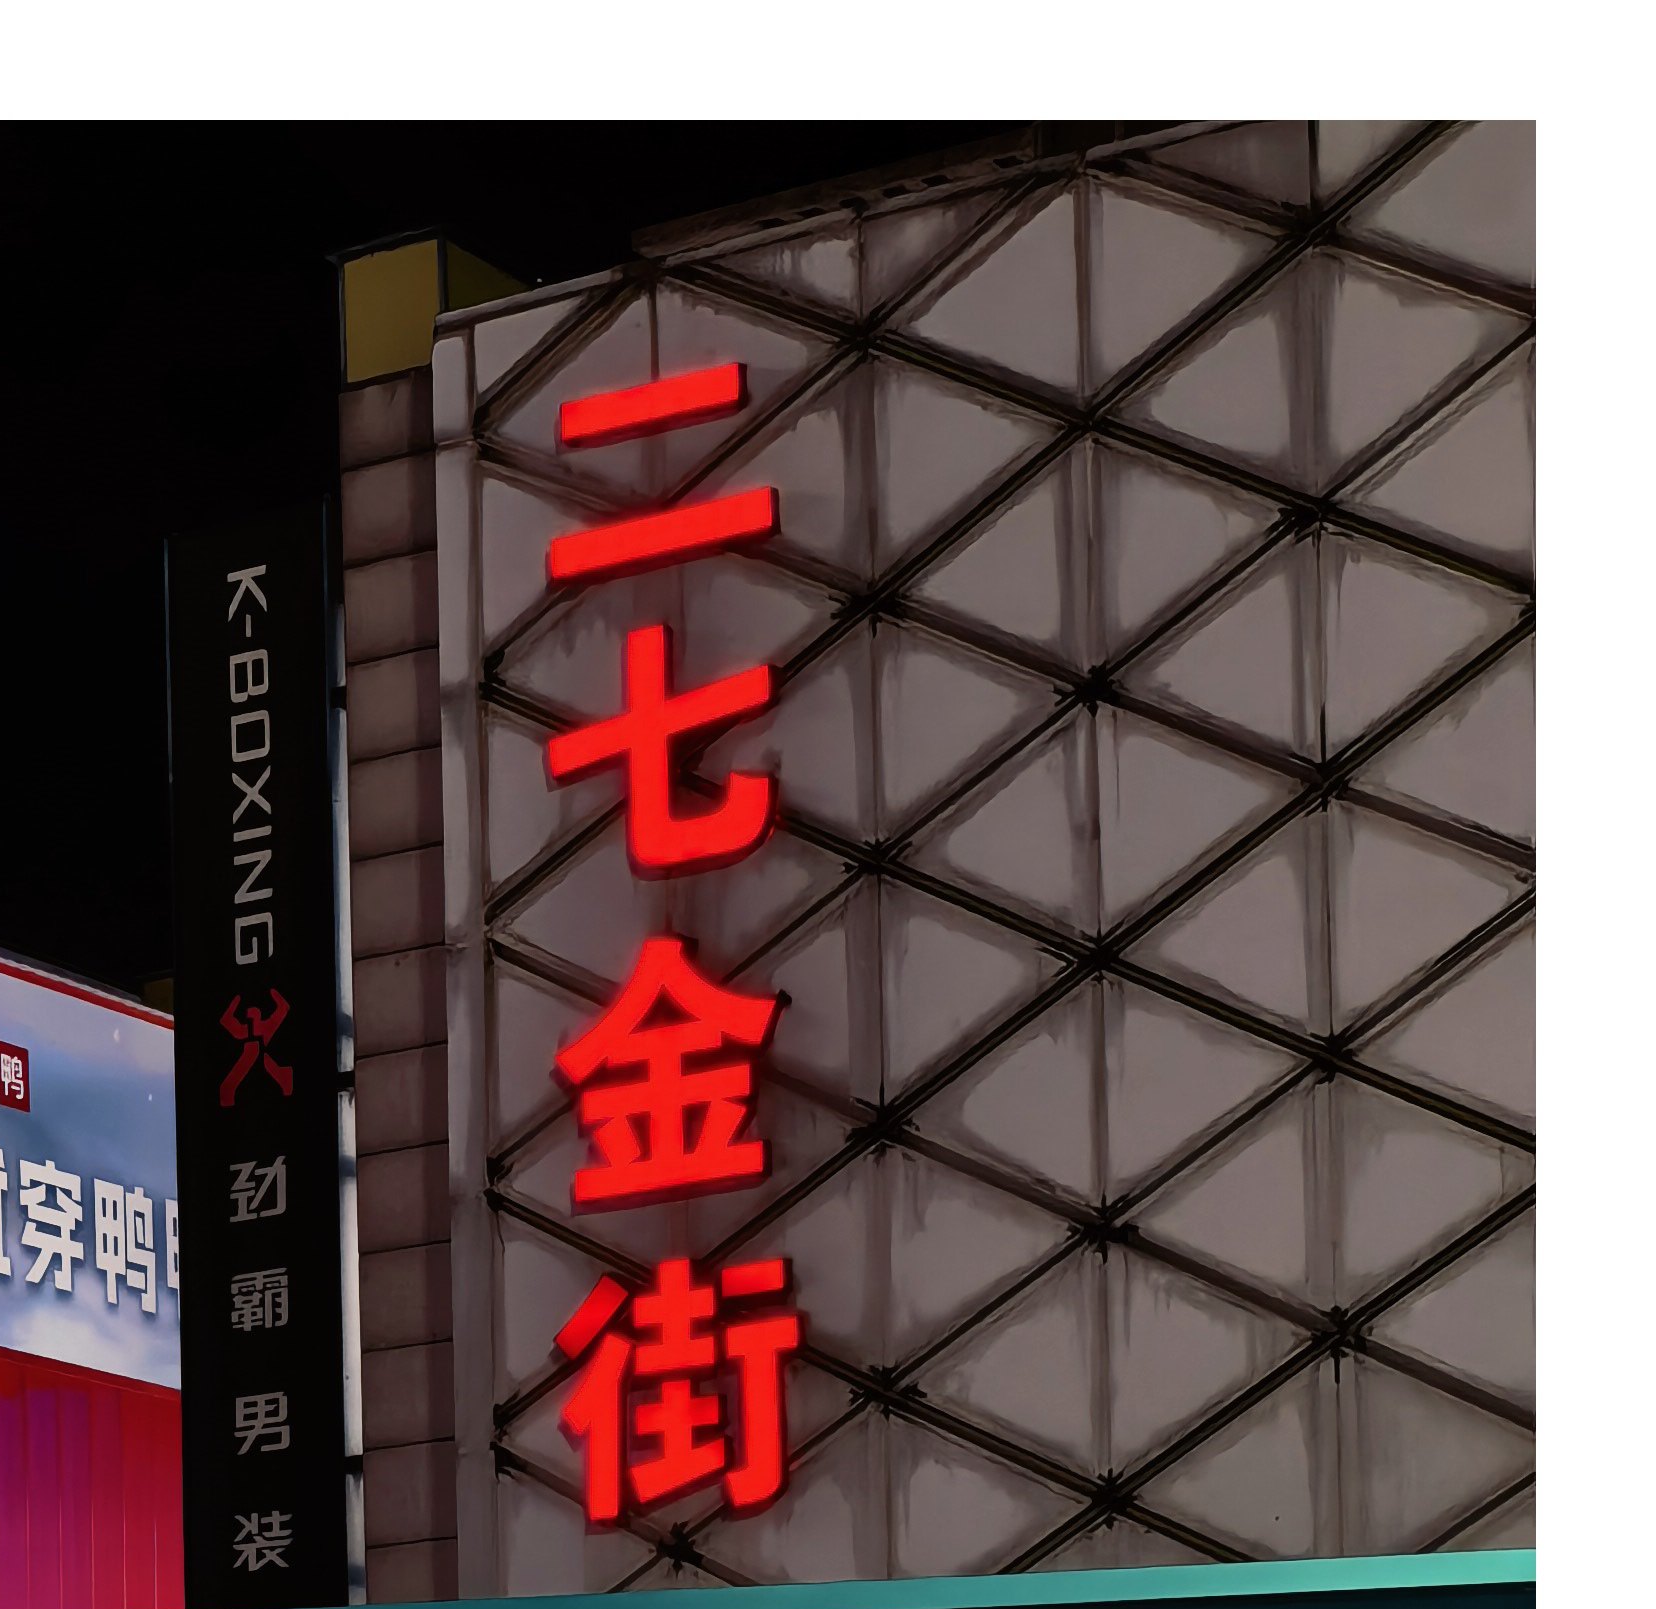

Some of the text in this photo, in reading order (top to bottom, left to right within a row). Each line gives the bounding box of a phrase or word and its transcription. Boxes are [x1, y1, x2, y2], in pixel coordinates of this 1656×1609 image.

[227, 563, 275, 966] K-BOXING
[546, 361, 799, 1522] 二七金街
[230, 1155, 294, 1573] 劲霸男装
